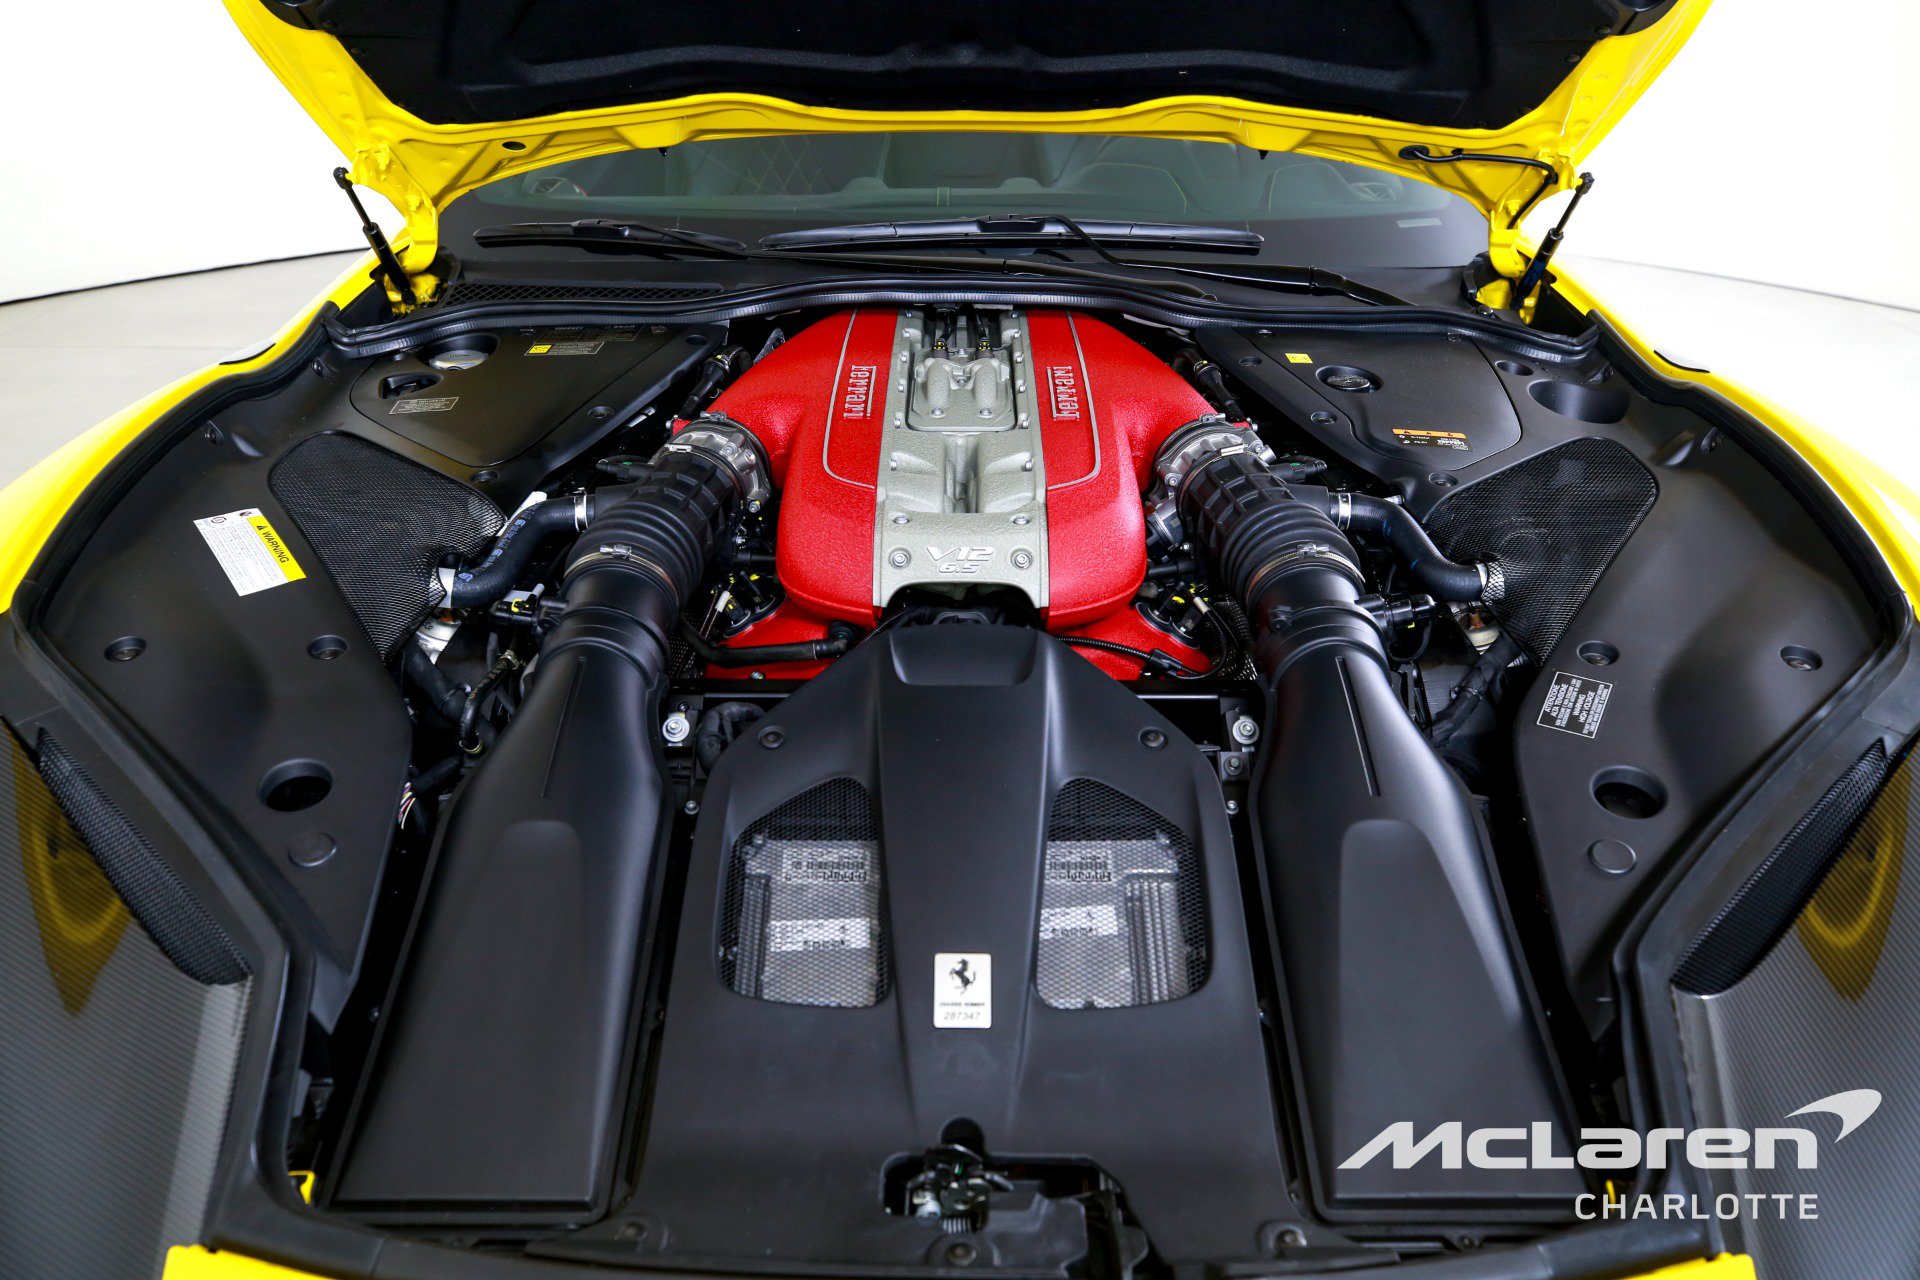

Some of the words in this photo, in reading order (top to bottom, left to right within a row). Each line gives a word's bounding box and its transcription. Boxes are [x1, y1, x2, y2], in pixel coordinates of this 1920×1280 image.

[843, 365, 876, 419] Ferrari
[1046, 366, 1080, 419] Ferrari
[262, 531, 290, 564] WARNING
[927, 547, 994, 561] V12
[939, 563, 980, 574] 6.5
[1545, 684, 1560, 712] ATTENZIONE
[1572, 694, 1586, 715] WARNING
[1583, 691, 1595, 710] VOLTAGE
[1550, 706, 1560, 717] ALTA
[1578, 711, 1589, 723] HIGH
